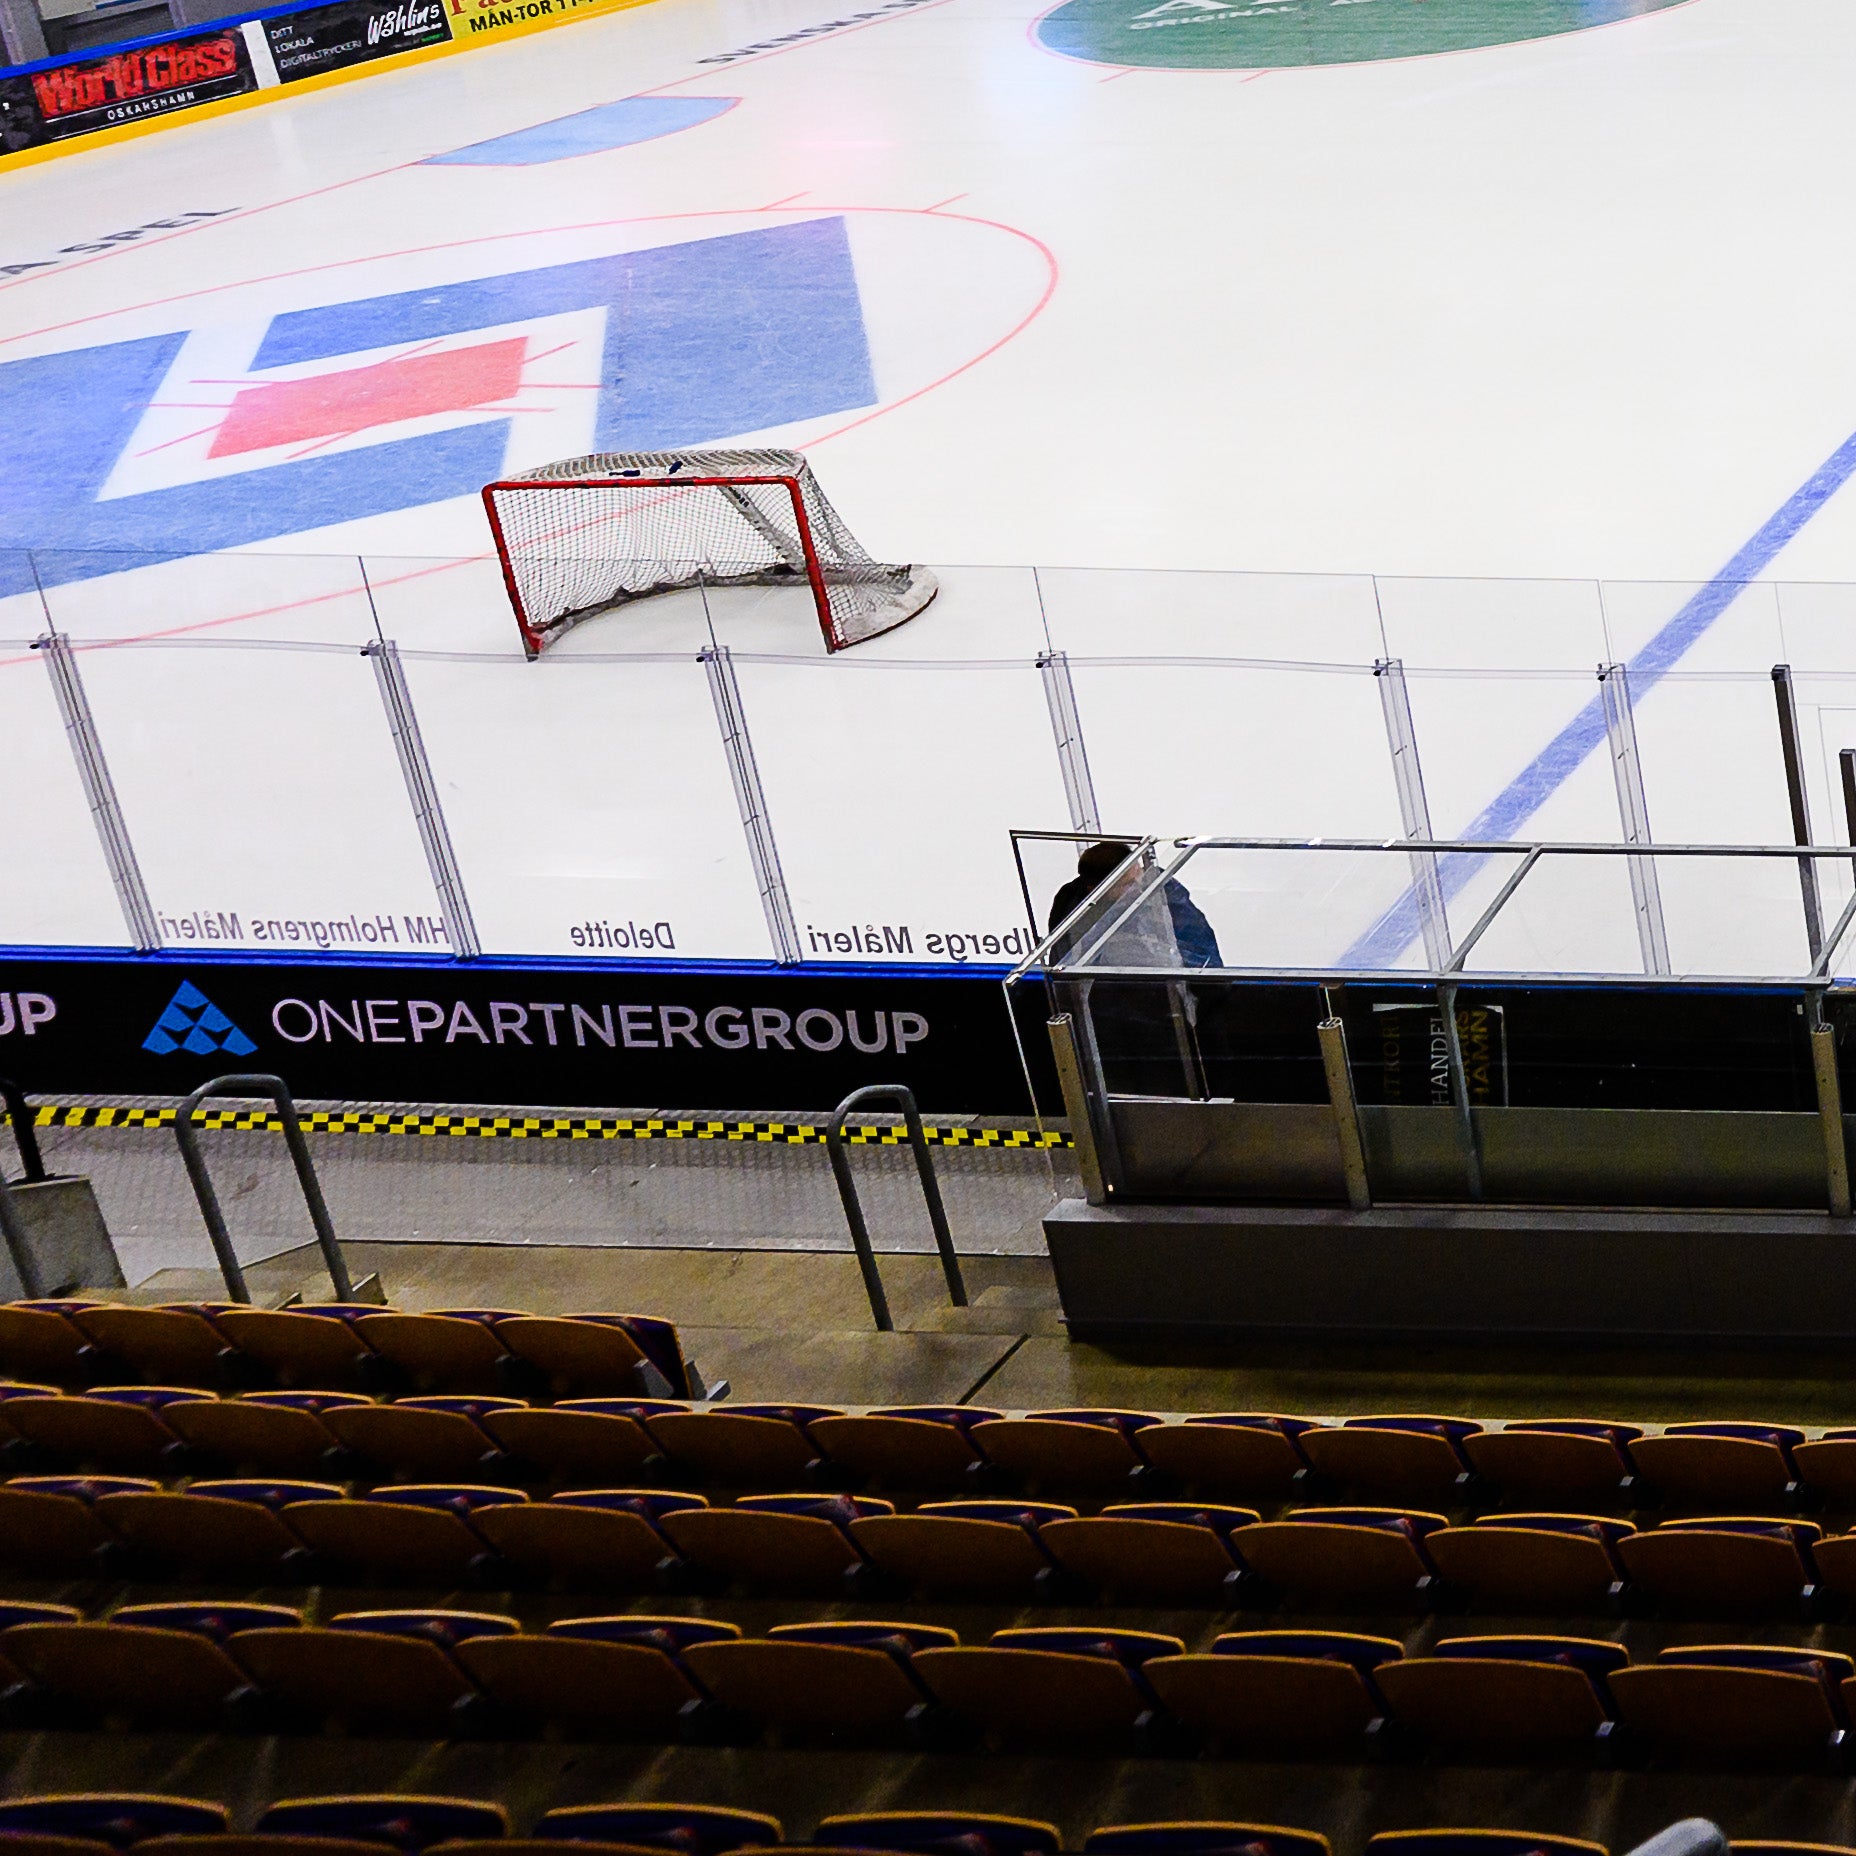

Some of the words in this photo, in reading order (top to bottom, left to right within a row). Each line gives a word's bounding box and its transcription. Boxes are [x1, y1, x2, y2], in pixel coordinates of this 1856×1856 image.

[469, 0, 554, 34] MÅN-TOR
[1130, 5, 1298, 31] ORIGINAL
[31, 53, 145, 119] World
[146, 39, 236, 92] Class
[107, 91, 196, 121] OSKARSHAMN
[271, 996, 929, 1057] ONEPARTNERGROUP
